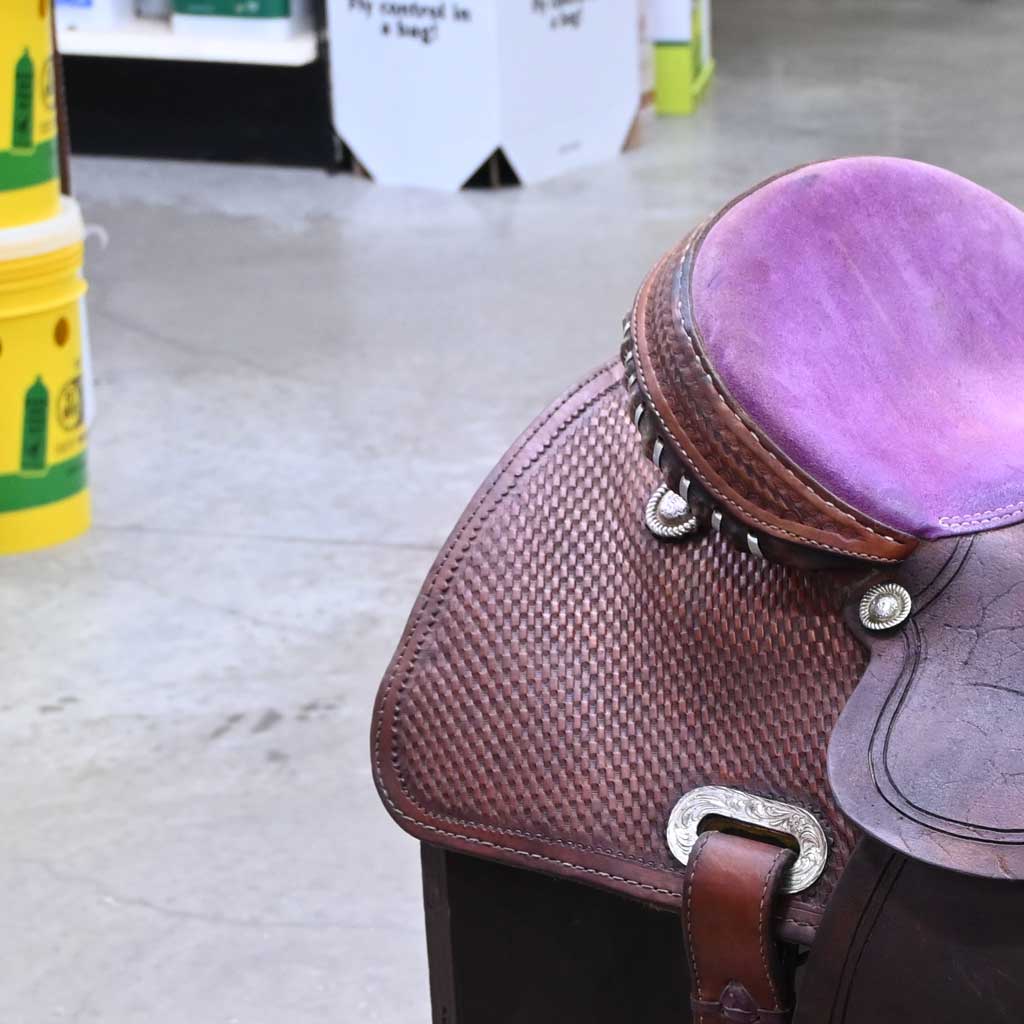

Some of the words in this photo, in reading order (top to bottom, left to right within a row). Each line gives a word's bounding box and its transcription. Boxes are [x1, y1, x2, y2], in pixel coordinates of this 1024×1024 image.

[380, 0, 444, 20] control
[453, 4, 471, 21] in
[381, 23, 390, 35] a
[398, 20, 436, 44] bag!
